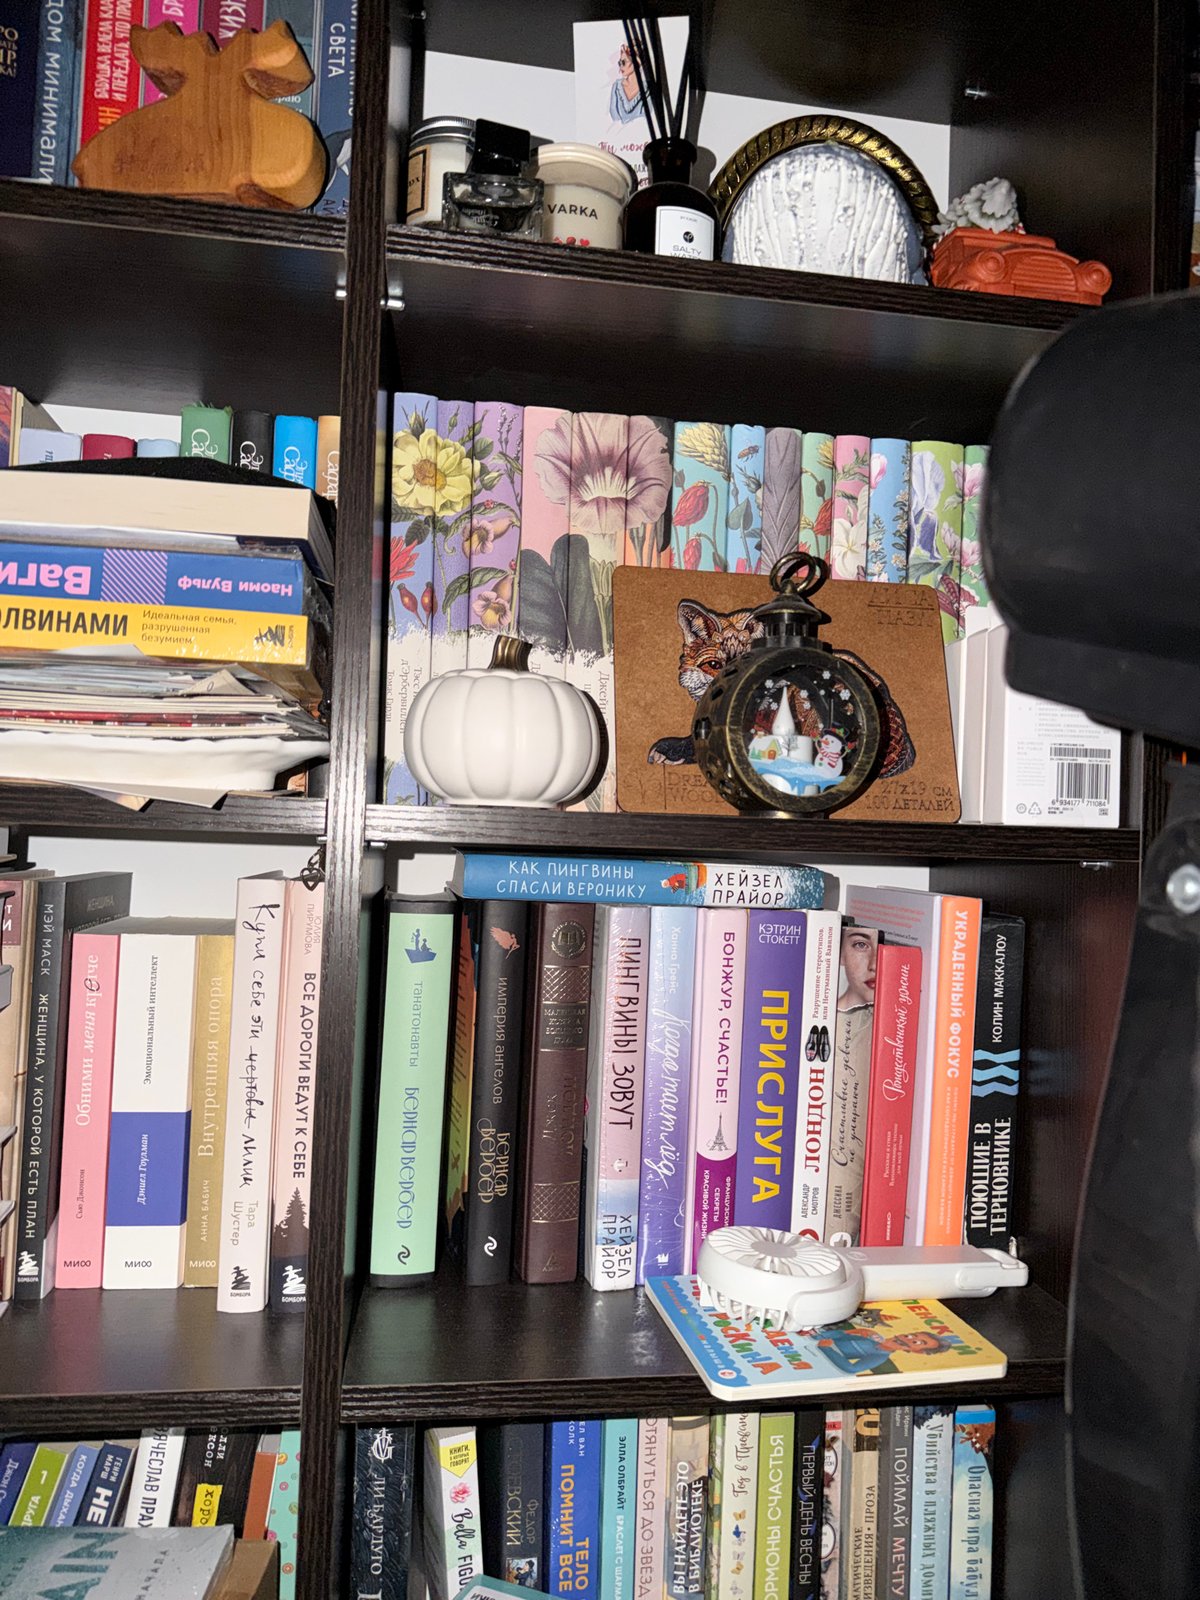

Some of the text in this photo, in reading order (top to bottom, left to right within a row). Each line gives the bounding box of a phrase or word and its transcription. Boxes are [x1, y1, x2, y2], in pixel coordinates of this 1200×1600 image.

[326, 23, 346, 78] СВЕТА
[547, 203, 599, 220] VARKA
[176, 575, 294, 597] Наоми Вульф
[0, 606, 129, 637] ЛВИНАМИ
[141, 623, 211, 636] разрушенная
[141, 632, 193, 645] безумием
[142, 609, 237, 626] Идеальная семья,
[892, 797, 955, 812] ДЕТАЛЕЙ
[496, 879, 647, 899] СПАСЛИ ВЕРОНИКУ
[509, 860, 634, 879] КАК ПИНГВИНЫ
[714, 869, 784, 889] ХЕЙЗЕЛ
[712, 888, 785, 905] ПРАЙОР
[242, 904, 281, 962] Купи
[303, 903, 315, 955] ПИРУМОВА
[313, 916, 322, 943] ЮЛИЯ
[758, 923, 801, 935] КЭТРИН
[758, 934, 801, 945] СТОКЕТТ
[826, 926, 834, 959] Вавилон
[250, 970, 266, 1007] себе
[668, 962, 681, 995] Грейс
[811, 971, 821, 1019] Разрушение
[823, 961, 832, 1008] Нетуманный
[946, 910, 969, 1078] УКРАДЕННЫЙ ФОКУС
[991, 934, 1008, 1043] КОЛИН МАККАЛОУ
[143, 955, 159, 1085] Эмоциональный интеллект
[249, 1016, 265, 1040] эти
[408, 980, 424, 1067] танатонавты
[491, 977, 508, 1105] империя ангелов
[608, 937, 642, 1131] ПИНГВИНЫ ЗОВУТ
[715, 931, 735, 1104] БОНЖУР, СЧАСТЬЕ!
[882, 1004, 911, 1102] Рождественский
[898, 963, 913, 1005] ужин
[25, 903, 54, 1239] МЭЙ МАСК ЖЕНЩИНА, У КОТОРОЙ ЕСТЬ ПЛАН
[75, 1012, 97, 1126] Обними меня
[198, 976, 226, 1157] Внутренняя опора
[293, 972, 317, 1178] ВСЕ ДОРОГИ ВЕДУТ К СЕБЕ
[751, 989, 790, 1204] ПРИСЛУГА
[831, 1020, 857, 1167] Счастливые девочки
[849, 1080, 864, 1148] умирают
[804, 1066, 828, 1174] ЛОНДОН
[136, 1134, 149, 1205] Дэниел Гоулман
[240, 1133, 257, 1188] лилии
[970, 1122, 992, 1229] ПОЮЩИЕ В
[989, 1117, 1012, 1237] ТЕРНОВНИКЕ
[75, 1169, 86, 1219] Сью Джонсон
[200, 1180, 209, 1242] АННА БАБИЧ
[702, 1169, 710, 1211] КРАСИВОЙ
[713, 1187, 721, 1222] СЕКРЕТЫ
[801, 1183, 810, 1218] АЛЕКСАНДР
[810, 1186, 820, 1216] СМОТРОВ
[230, 1201, 244, 1246] Шустер
[248, 1200, 259, 1228] Тара
[601, 1214, 618, 1280] ПРАЙОР
[615, 1214, 633, 1279] ХЕЙЗЕЛ
[68, 1454, 88, 1489] КОГДА
[100, 1454, 115, 1480] МАРШ
[110, 1456, 124, 1484] ГЕНРИ
[616, 1436, 627, 1463] ЭЛЛА
[925, 1424, 944, 1485] Убийства
[373, 1474, 386, 1499] ЛИ
[616, 1464, 627, 1510] ОЛБРАЙТ
[675, 1461, 690, 1493] ЭТО
[767, 1435, 785, 1521] СЧАСТЬЯ
[86, 1486, 113, 1525] НЕ
[525, 1500, 540, 1545] ФЕДОР
[558, 1464, 576, 1592] ПОМНИТ ВСЕ
[798, 1445, 816, 1585] ПЕРВЫЙ ДЕНЬ ВЕСНЫ
[864, 1485, 876, 1524] ПРОЗА
[891, 1447, 909, 1596] ПОЙМАЙ МЕЧТУ
[961, 1465, 987, 1554] Опасная игра
[367, 1503, 385, 1576] БАРДУГО
[450, 1507, 476, 1551] Bella
[615, 1514, 624, 1556] БРАСЛЕТ
[640, 1517, 655, 1542] ДО
[688, 1480, 704, 1594] В БИБЛИОТЕКЕ
[921, 1500, 937, 1558] пляжных
[574, 1536, 590, 1591] ТЕЛО
[673, 1573, 685, 1595] ВЫ
